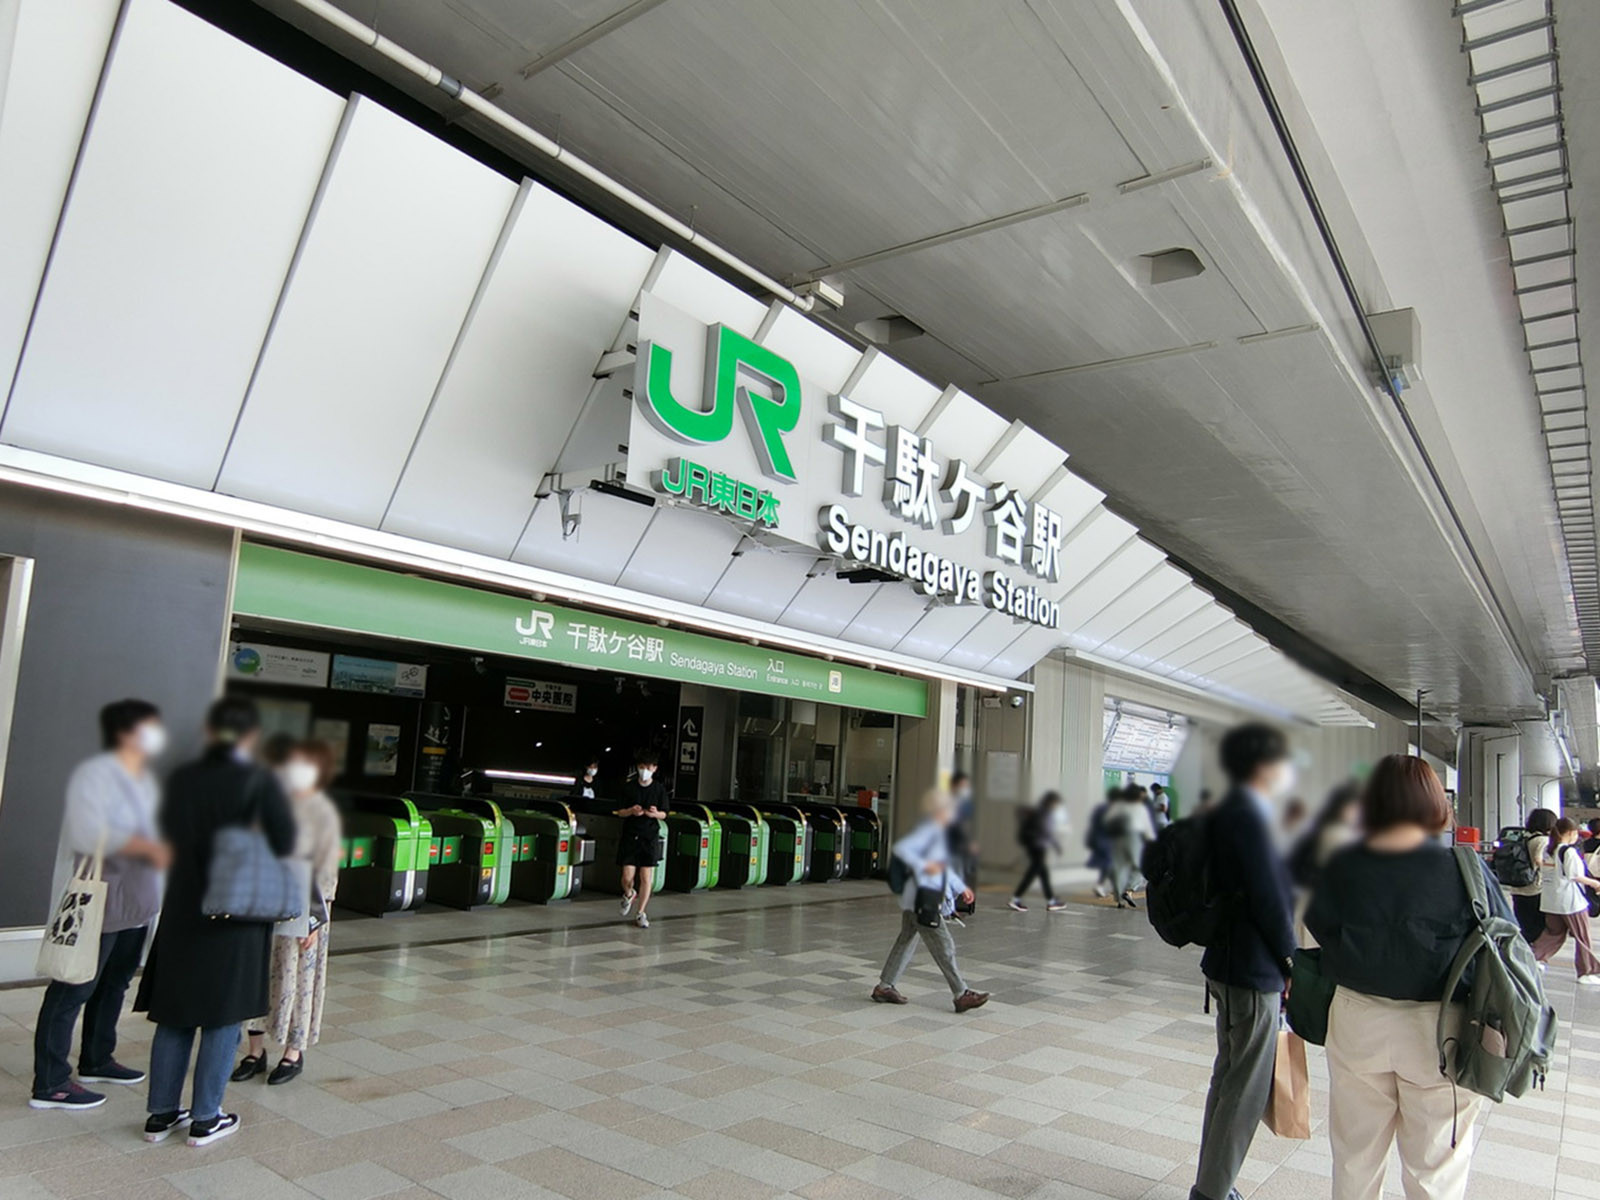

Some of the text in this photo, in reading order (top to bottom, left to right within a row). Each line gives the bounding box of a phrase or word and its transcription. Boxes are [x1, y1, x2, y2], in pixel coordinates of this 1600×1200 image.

[638, 323, 802, 483] JR
[663, 458, 780, 528] JR東日本
[820, 505, 1060, 628] Sendagaya Station
[515, 610, 555, 639] JR
[670, 652, 758, 679] Sendagaya Station
[767, 658, 784, 673] 入口
